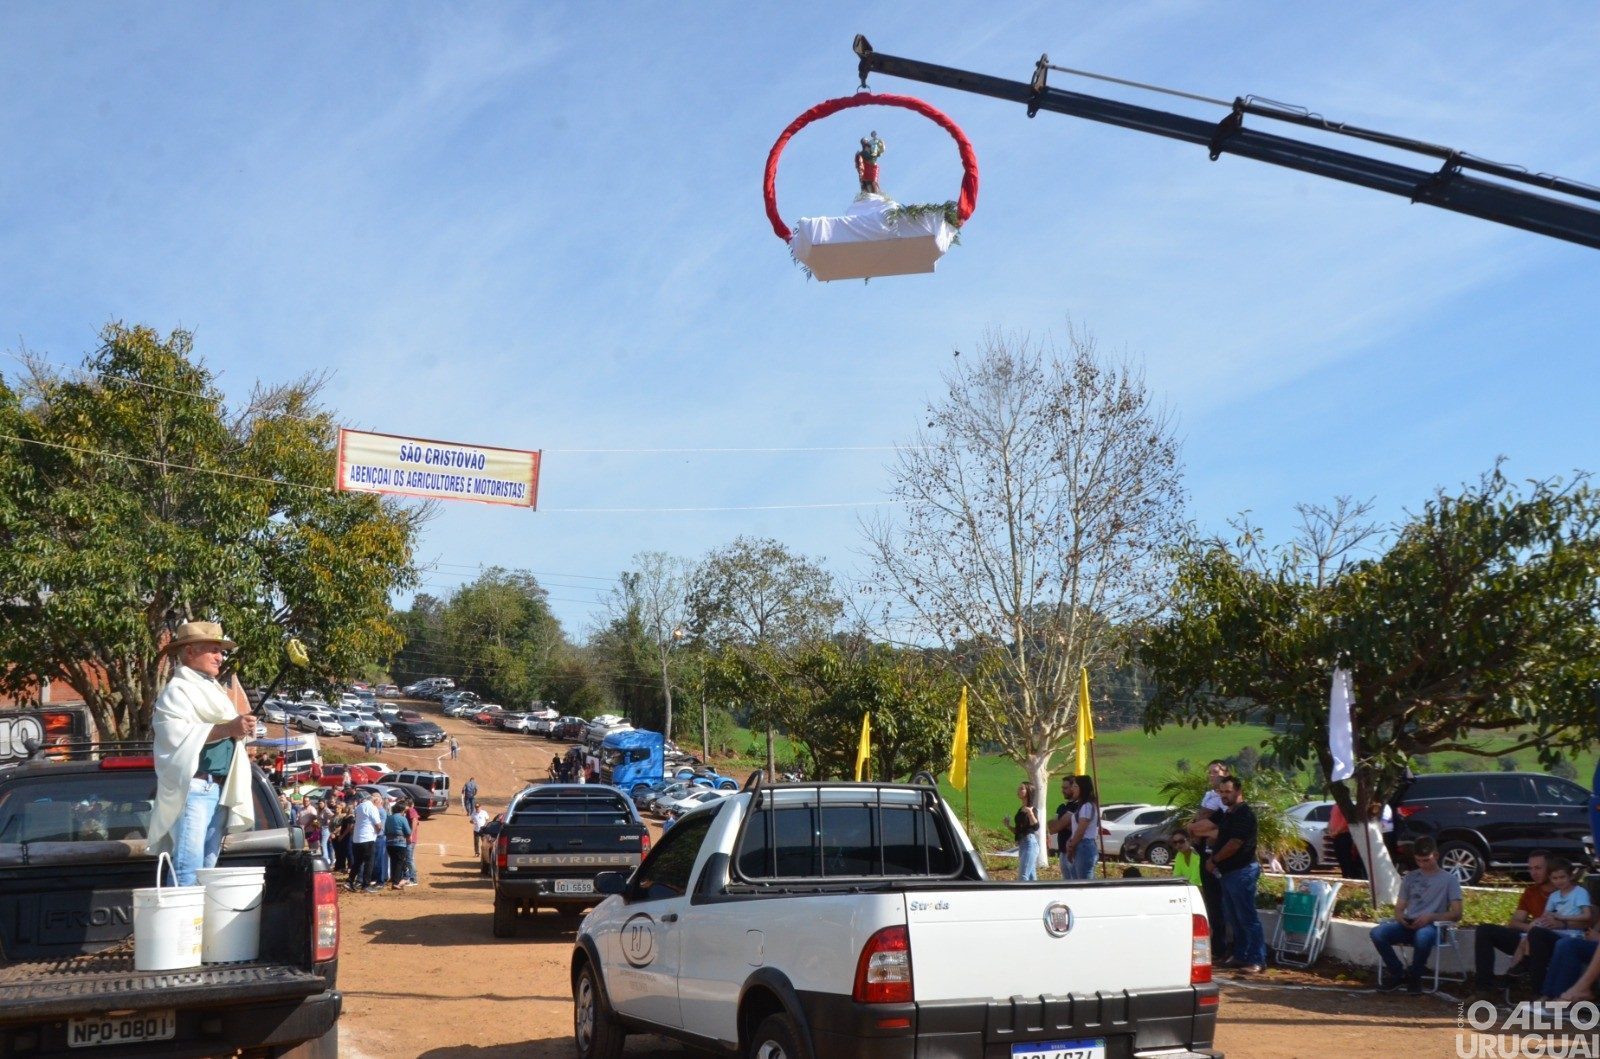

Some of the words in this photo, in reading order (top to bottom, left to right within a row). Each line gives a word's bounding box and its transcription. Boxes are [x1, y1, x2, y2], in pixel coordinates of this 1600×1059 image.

[400, 442, 421, 463] SÃO
[425, 448, 486, 471] CRISTÓVÃO
[350, 465, 391, 488] ABENÇOAI
[393, 469, 404, 487] OS
[406, 471, 465, 493] AGRICULTORES
[467, 477, 472, 493] E
[473, 478, 525, 499] MOTORISTAS!
[516, 856, 633, 864] CHEVROLET
[45, 904, 134, 930] FRON
[631, 925, 643, 951] PJ
